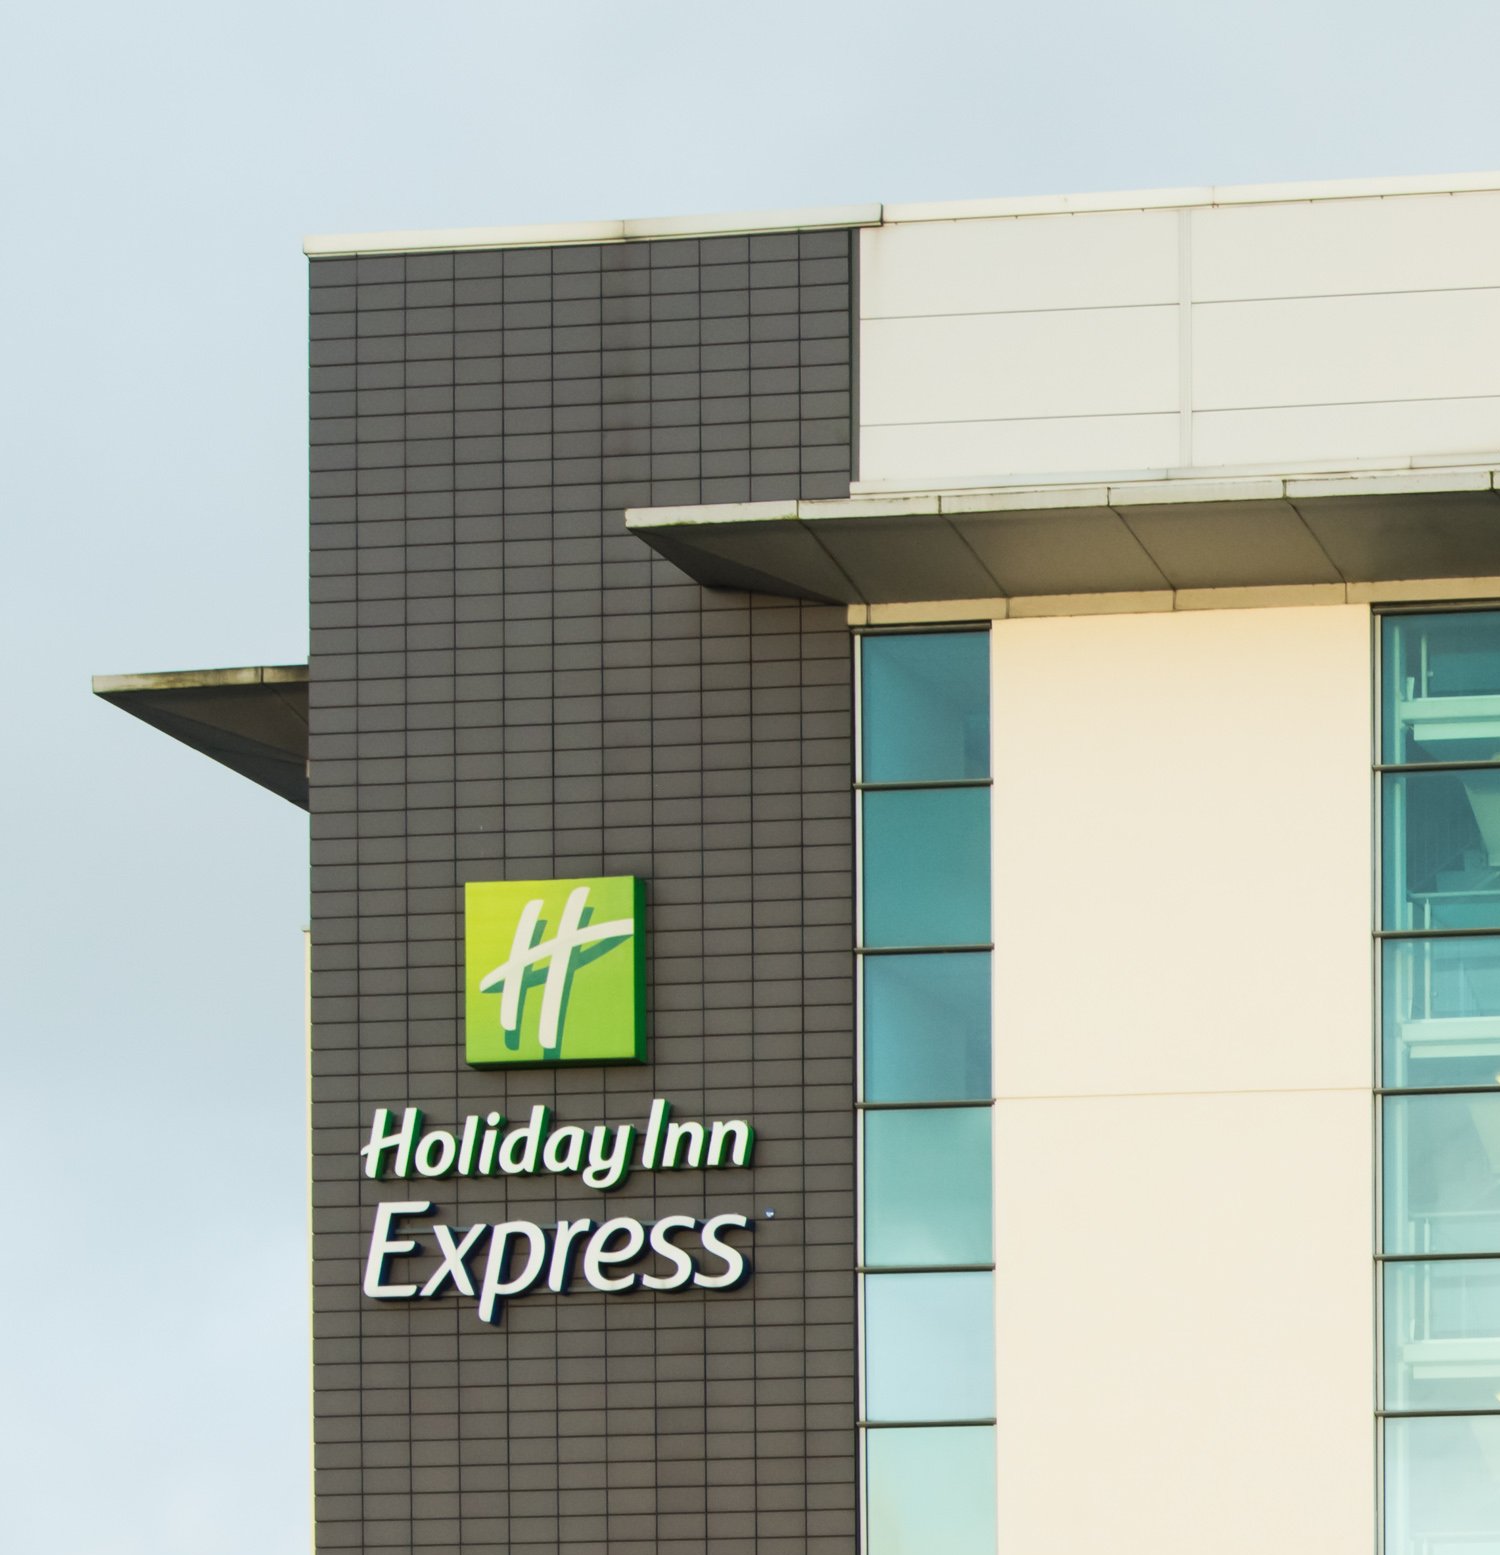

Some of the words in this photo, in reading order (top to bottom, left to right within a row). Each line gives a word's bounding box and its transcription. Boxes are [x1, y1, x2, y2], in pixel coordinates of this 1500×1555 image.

[361, 1104, 635, 1189] Holiday
[642, 1098, 752, 1170] Inn
[364, 1200, 749, 1322] Express
